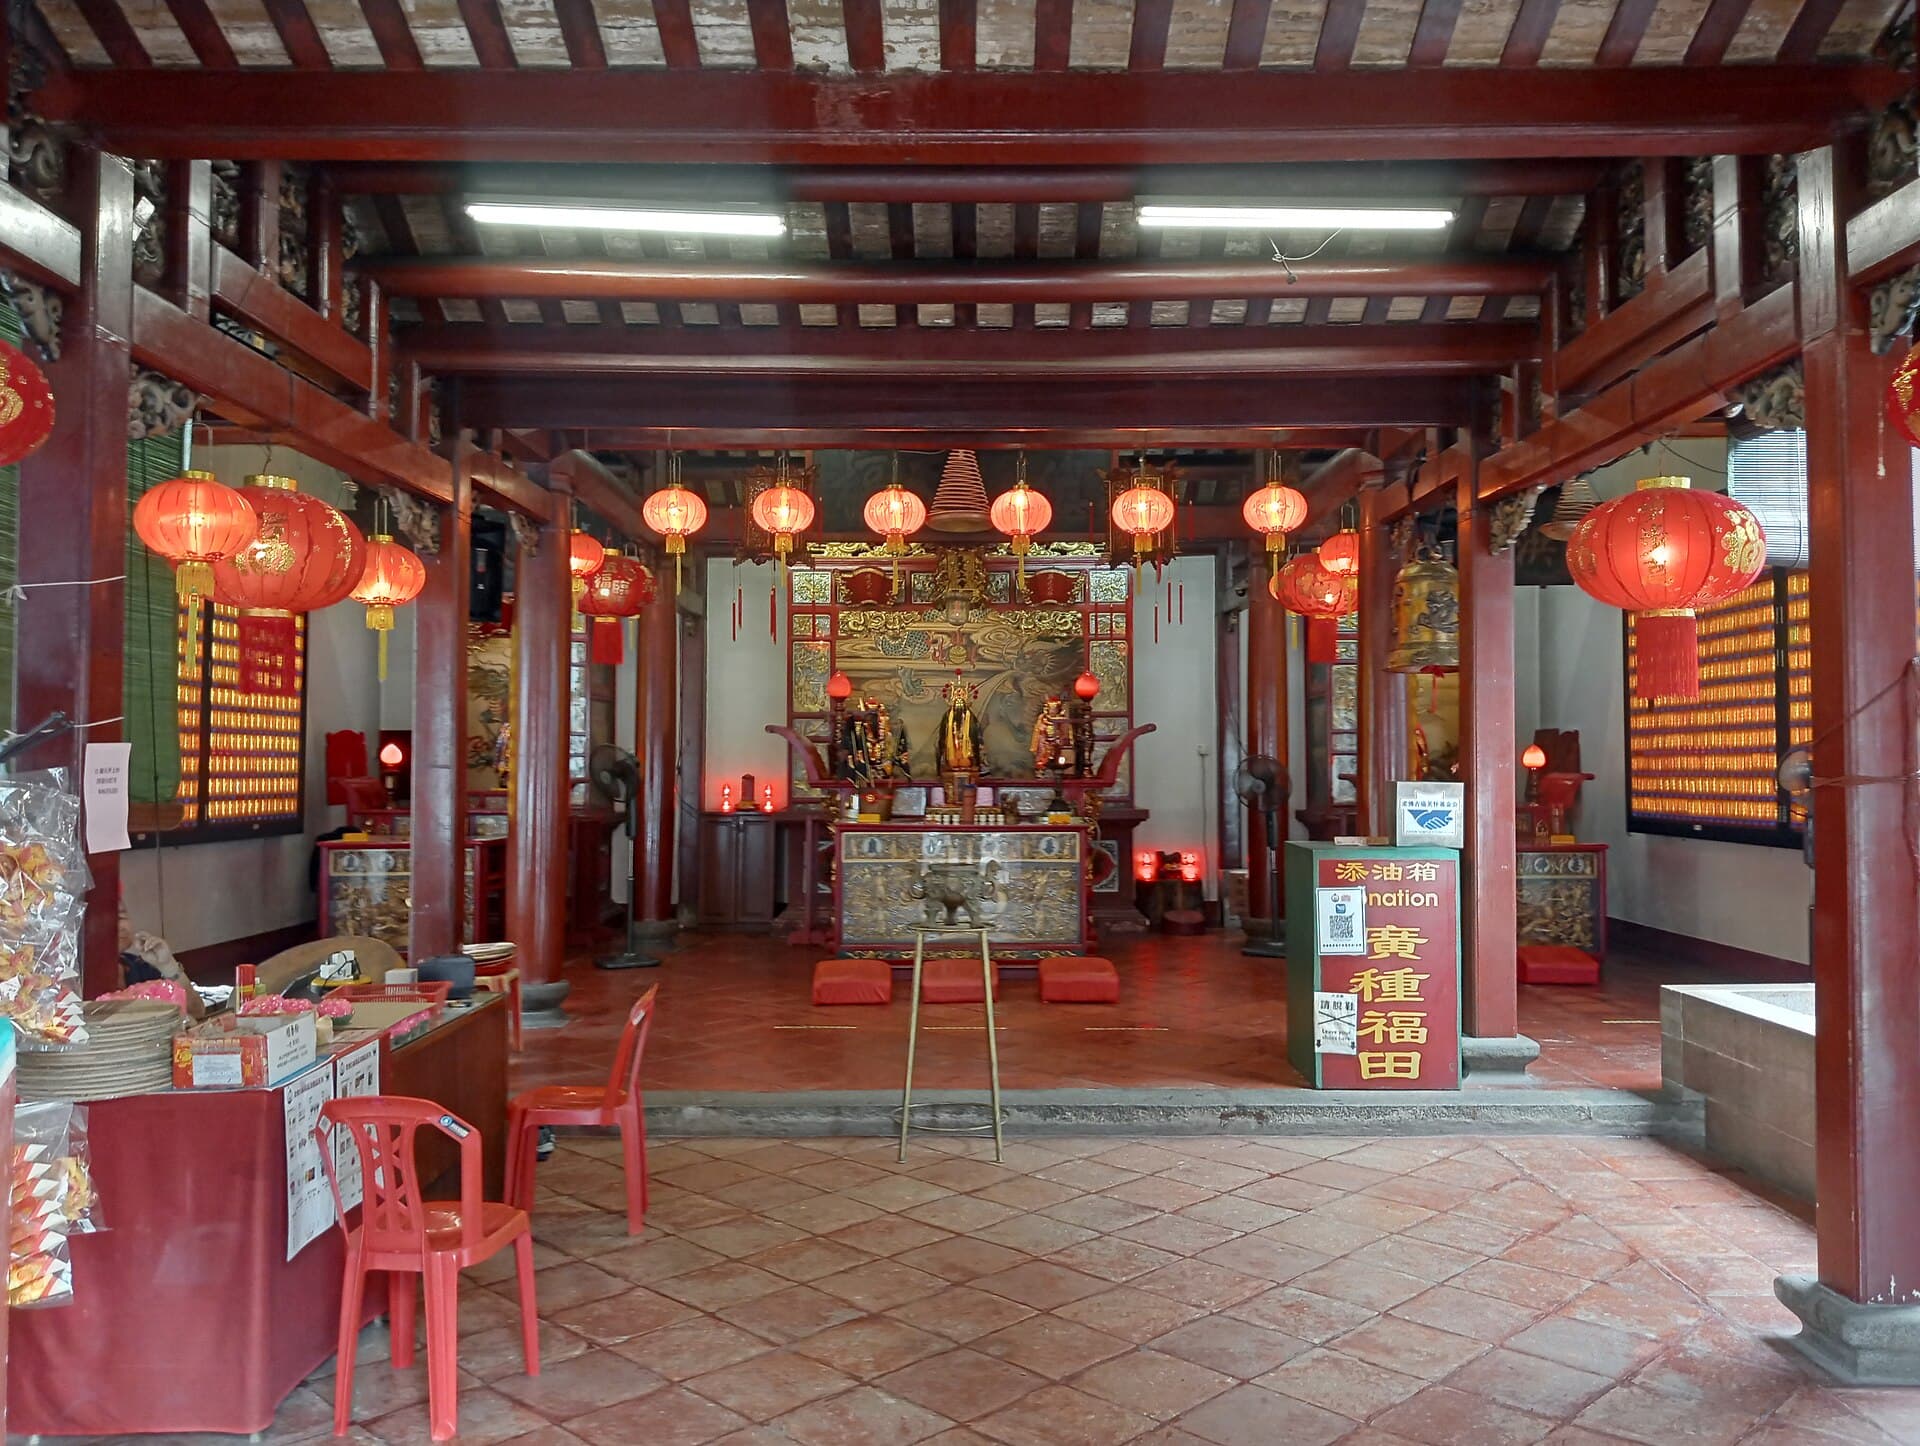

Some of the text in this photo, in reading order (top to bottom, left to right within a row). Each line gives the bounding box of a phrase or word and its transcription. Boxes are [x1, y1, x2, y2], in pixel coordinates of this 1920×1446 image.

[1335, 862, 1440, 882] 添油箱
[1363, 889, 1439, 907] nation
